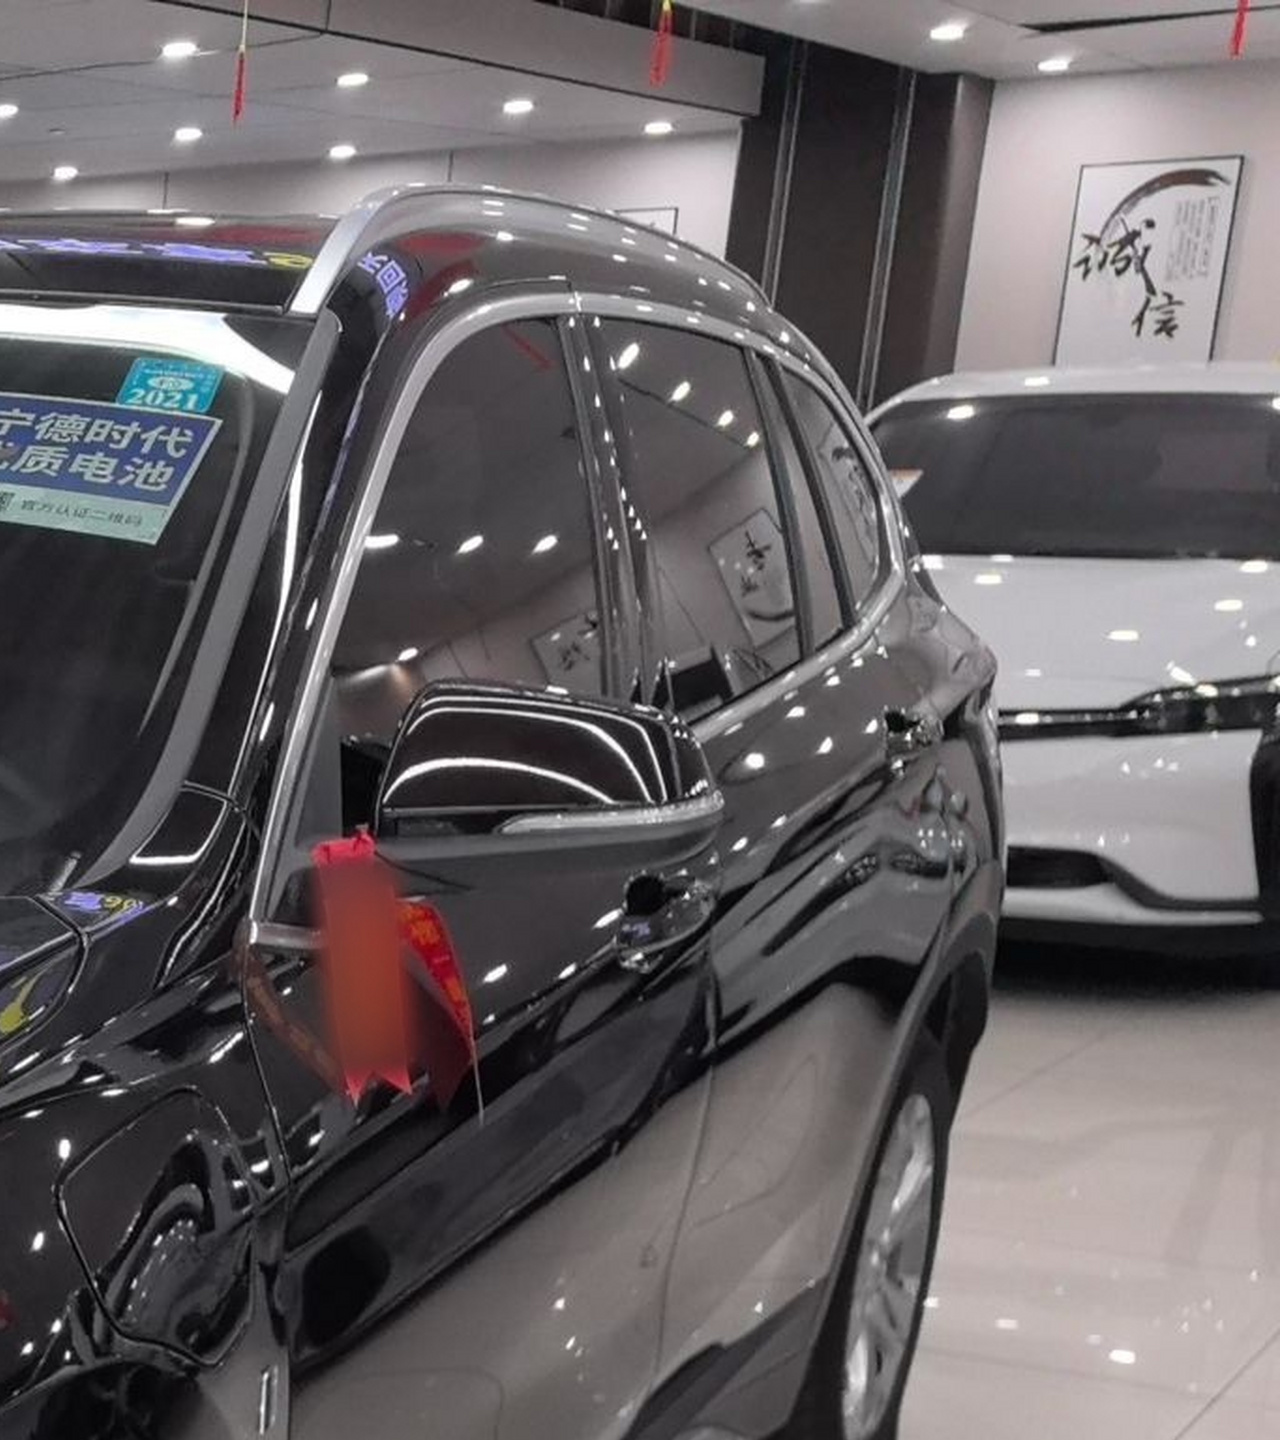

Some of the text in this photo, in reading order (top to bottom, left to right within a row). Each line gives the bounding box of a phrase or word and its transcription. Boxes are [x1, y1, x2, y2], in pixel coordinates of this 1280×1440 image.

[125, 387, 199, 411] 2021
[20, 499, 143, 526] 官方认证二维码
